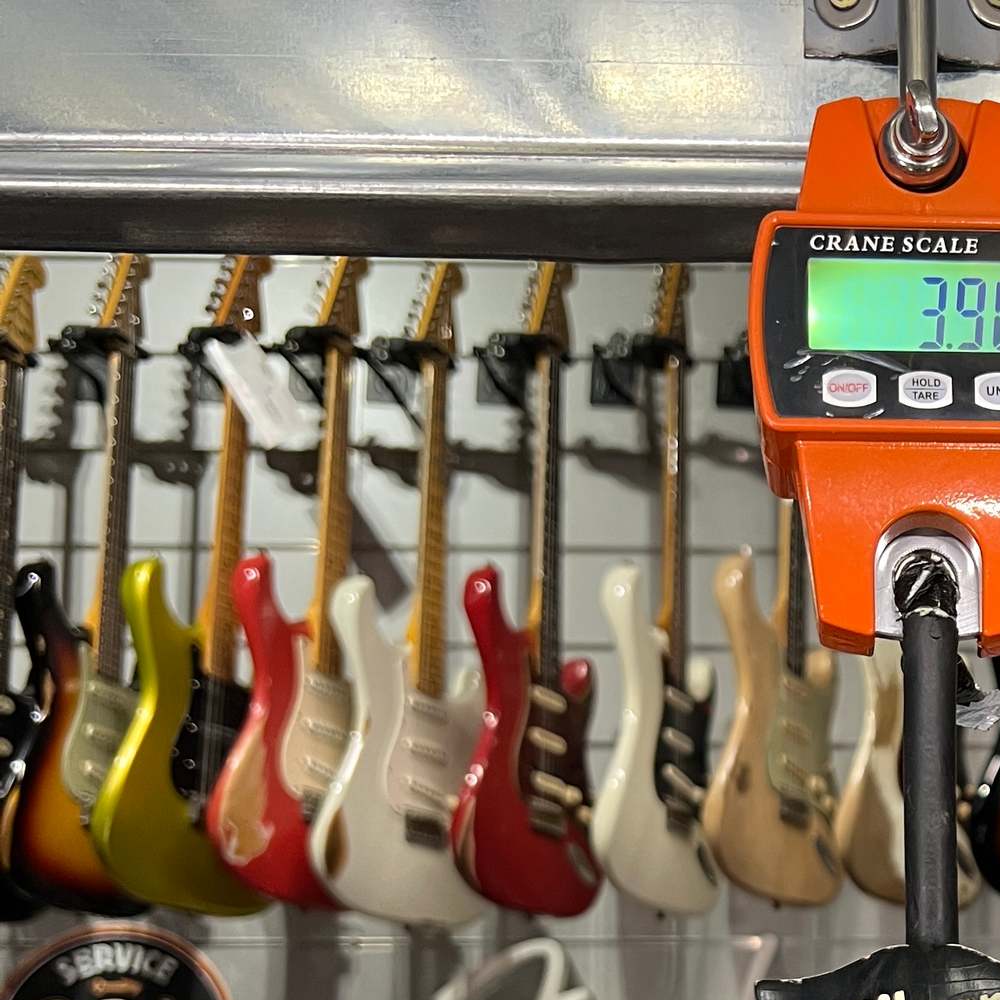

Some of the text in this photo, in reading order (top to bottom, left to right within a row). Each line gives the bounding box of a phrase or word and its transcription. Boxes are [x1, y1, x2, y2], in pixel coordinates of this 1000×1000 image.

[809, 234, 979, 254] CRANE SCALE
[828, 382, 869, 394] ON/OFF
[911, 376, 941, 388] HOLD
[911, 390, 940, 401] TARE
[54, 941, 179, 987] SERVICE
